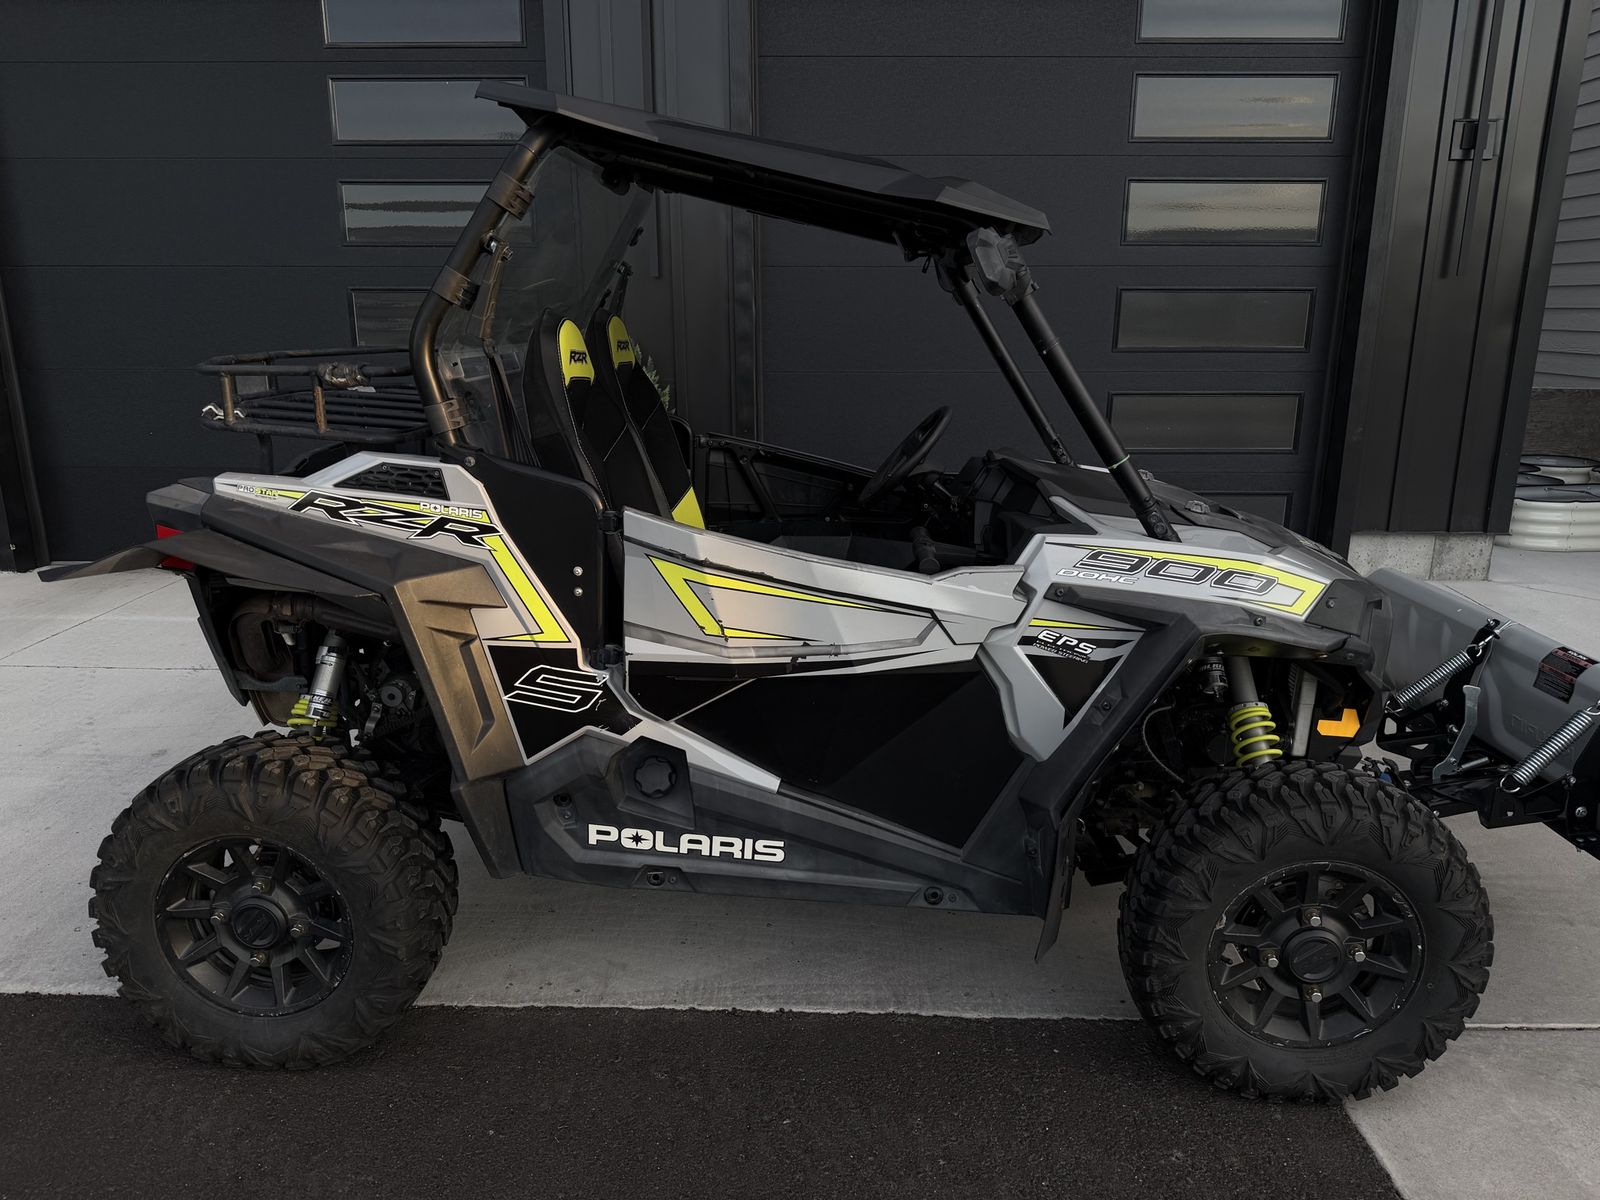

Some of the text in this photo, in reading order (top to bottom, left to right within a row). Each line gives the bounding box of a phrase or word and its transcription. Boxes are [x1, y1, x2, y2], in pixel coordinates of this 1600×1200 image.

[569, 350, 588, 365] RZR
[287, 489, 504, 551] RZR
[419, 501, 483, 519] POLARIS
[1056, 568, 1141, 585] DOHC
[1073, 549, 1279, 596] 900
[1037, 629, 1097, 654] EPS
[587, 823, 786, 863] POLARIS
